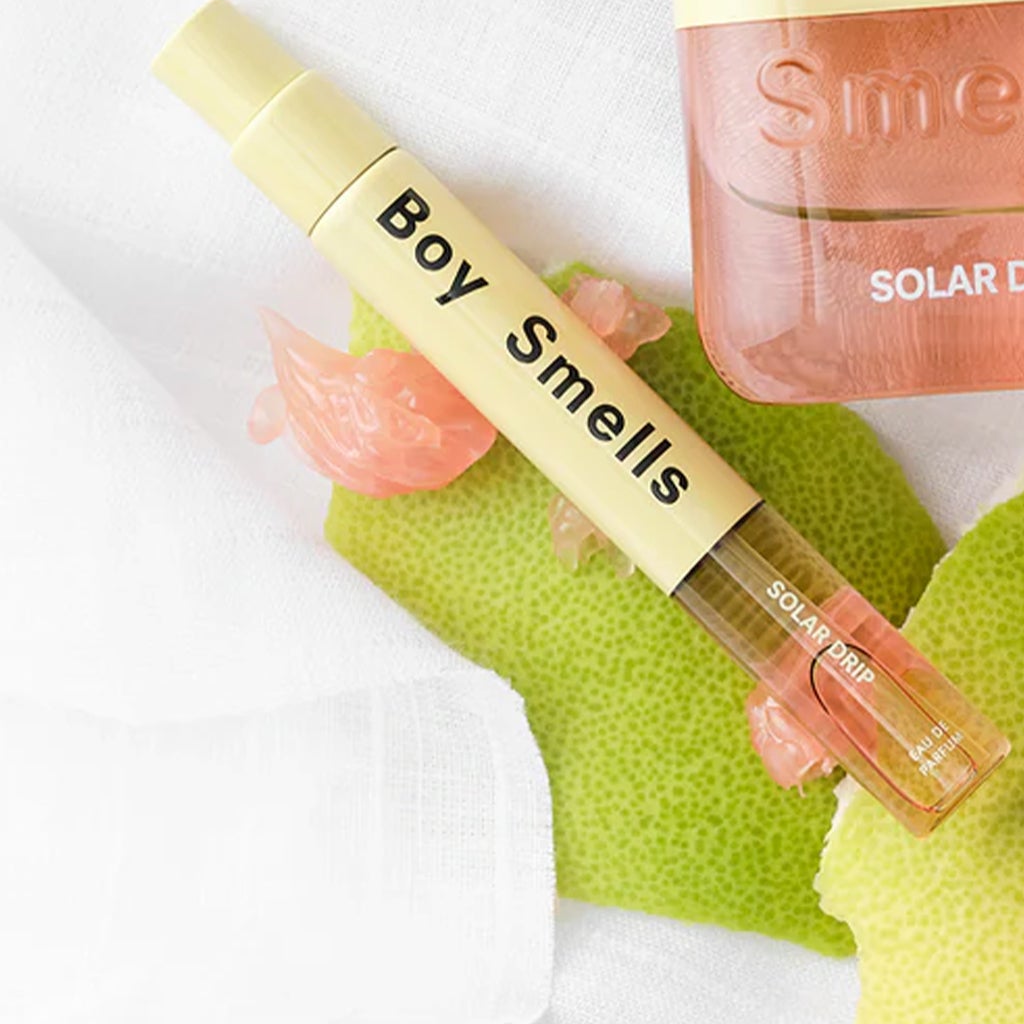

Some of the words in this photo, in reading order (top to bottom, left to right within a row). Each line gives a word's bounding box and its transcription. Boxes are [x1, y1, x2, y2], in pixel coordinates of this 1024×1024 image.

[870, 263, 998, 302] SOLAR
[375, 187, 489, 306] Boy
[506, 315, 689, 505] Smells
[766, 580, 831, 644] SOLAR
[827, 640, 875, 684] DRIP
[909, 735, 934, 761] EAU
[919, 732, 964, 776] PARFUM
